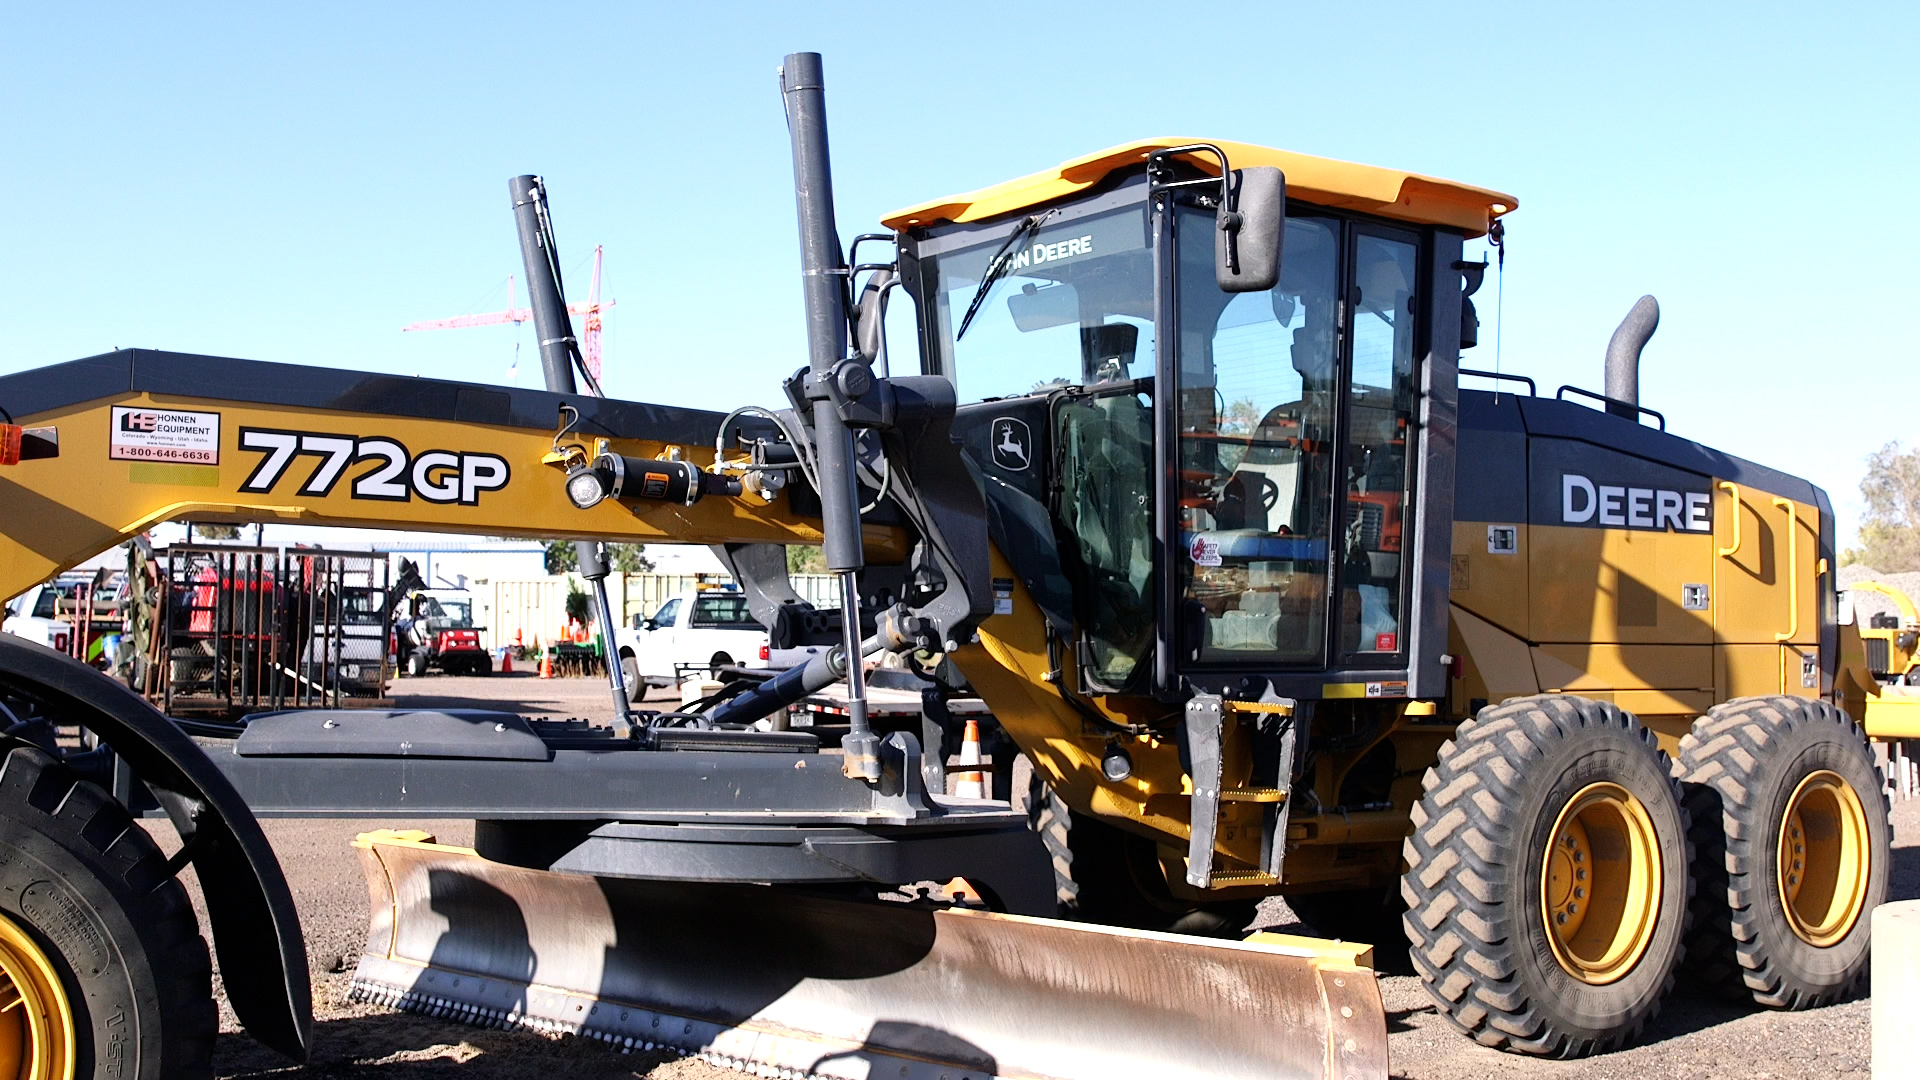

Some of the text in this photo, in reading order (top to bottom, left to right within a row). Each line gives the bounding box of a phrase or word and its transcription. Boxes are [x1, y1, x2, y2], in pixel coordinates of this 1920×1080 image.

[1033, 235, 1092, 265] DEERE
[157, 414, 196, 424] HONNEN
[157, 425, 210, 435] EQUIPMENT
[150, 434, 174, 442] Wyoming
[119, 447, 210, 460] 1-800-646-6636
[241, 429, 508, 504] 772GP
[1562, 473, 1710, 531] DEERE
[23, 903, 43, 921] CUT
[43, 921, 82, 974] RESISTANT
[47, 891, 75, 919] LOADER
[80, 926, 99, 956] DOZER
